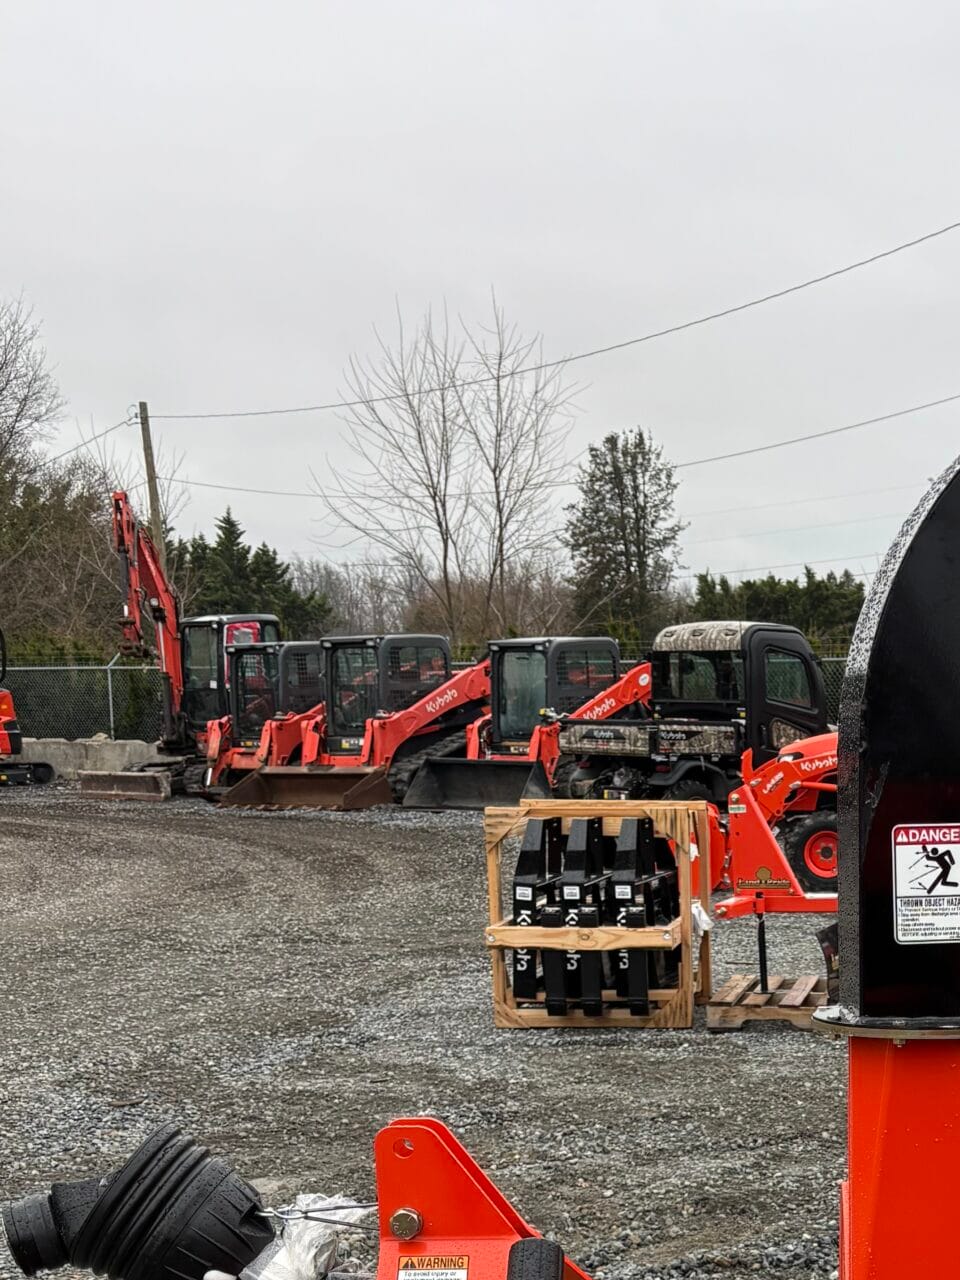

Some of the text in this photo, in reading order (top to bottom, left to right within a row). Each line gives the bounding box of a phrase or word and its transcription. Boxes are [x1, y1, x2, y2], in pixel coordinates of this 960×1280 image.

[425, 688, 458, 713] Kubota
[583, 697, 617, 720] Kubota
[925, 897, 945, 907] OBJECT
[417, 1256, 464, 1268] WARNING
